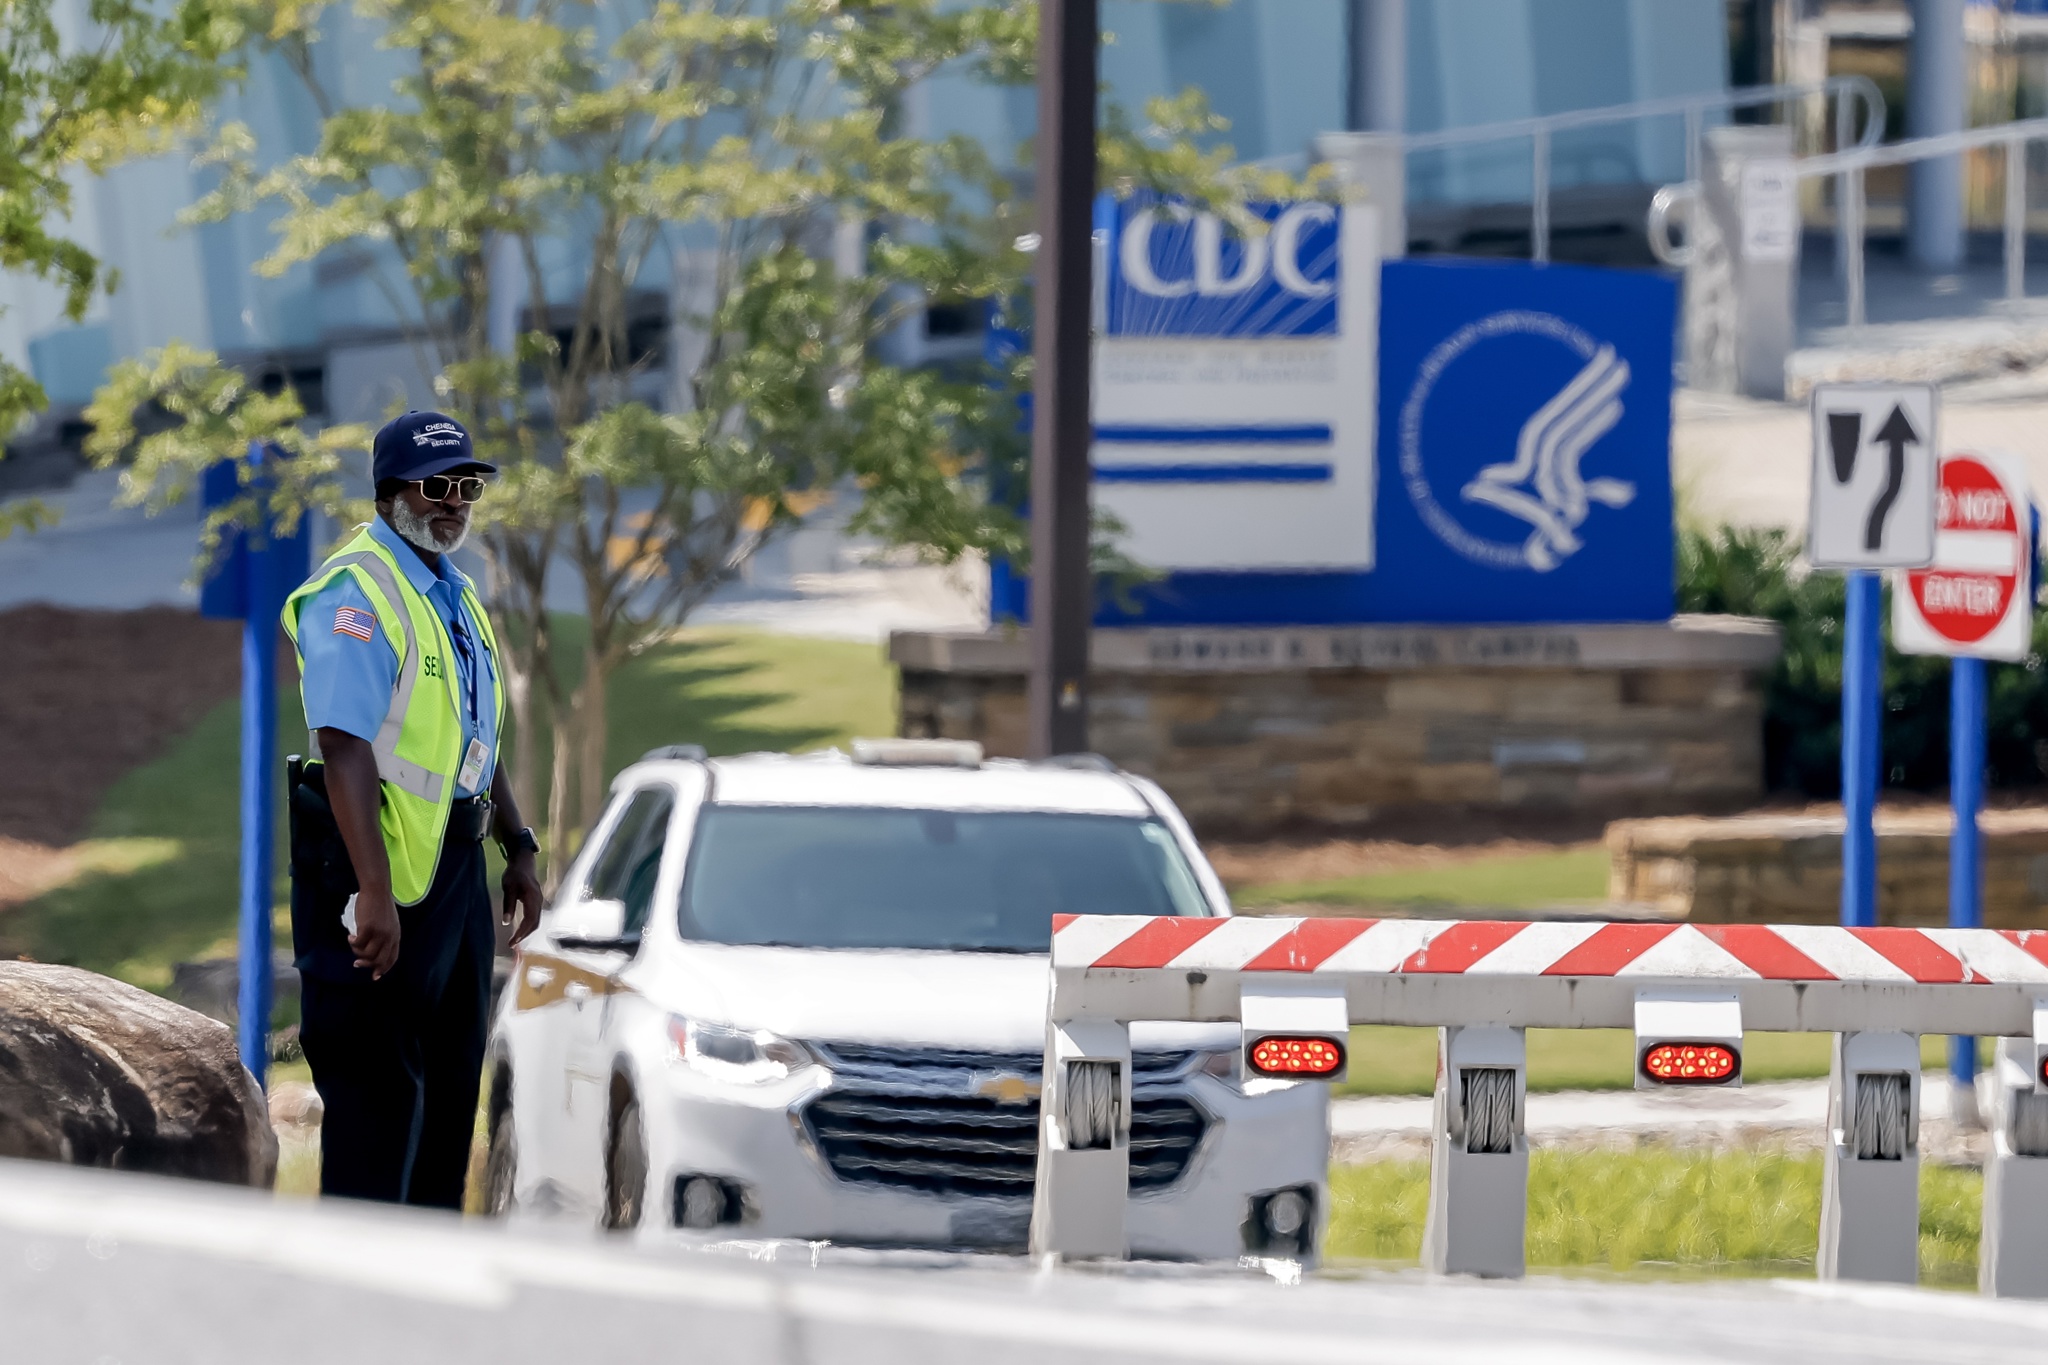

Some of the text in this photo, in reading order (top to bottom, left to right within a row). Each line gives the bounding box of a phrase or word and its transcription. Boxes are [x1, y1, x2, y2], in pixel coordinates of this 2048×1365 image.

[1120, 202, 1336, 298] CDC
[425, 422, 456, 432] CHENEGA
[431, 439, 461, 447] SECURITY
[1958, 488, 2006, 524] NOT
[1923, 576, 2002, 615] ENTER
